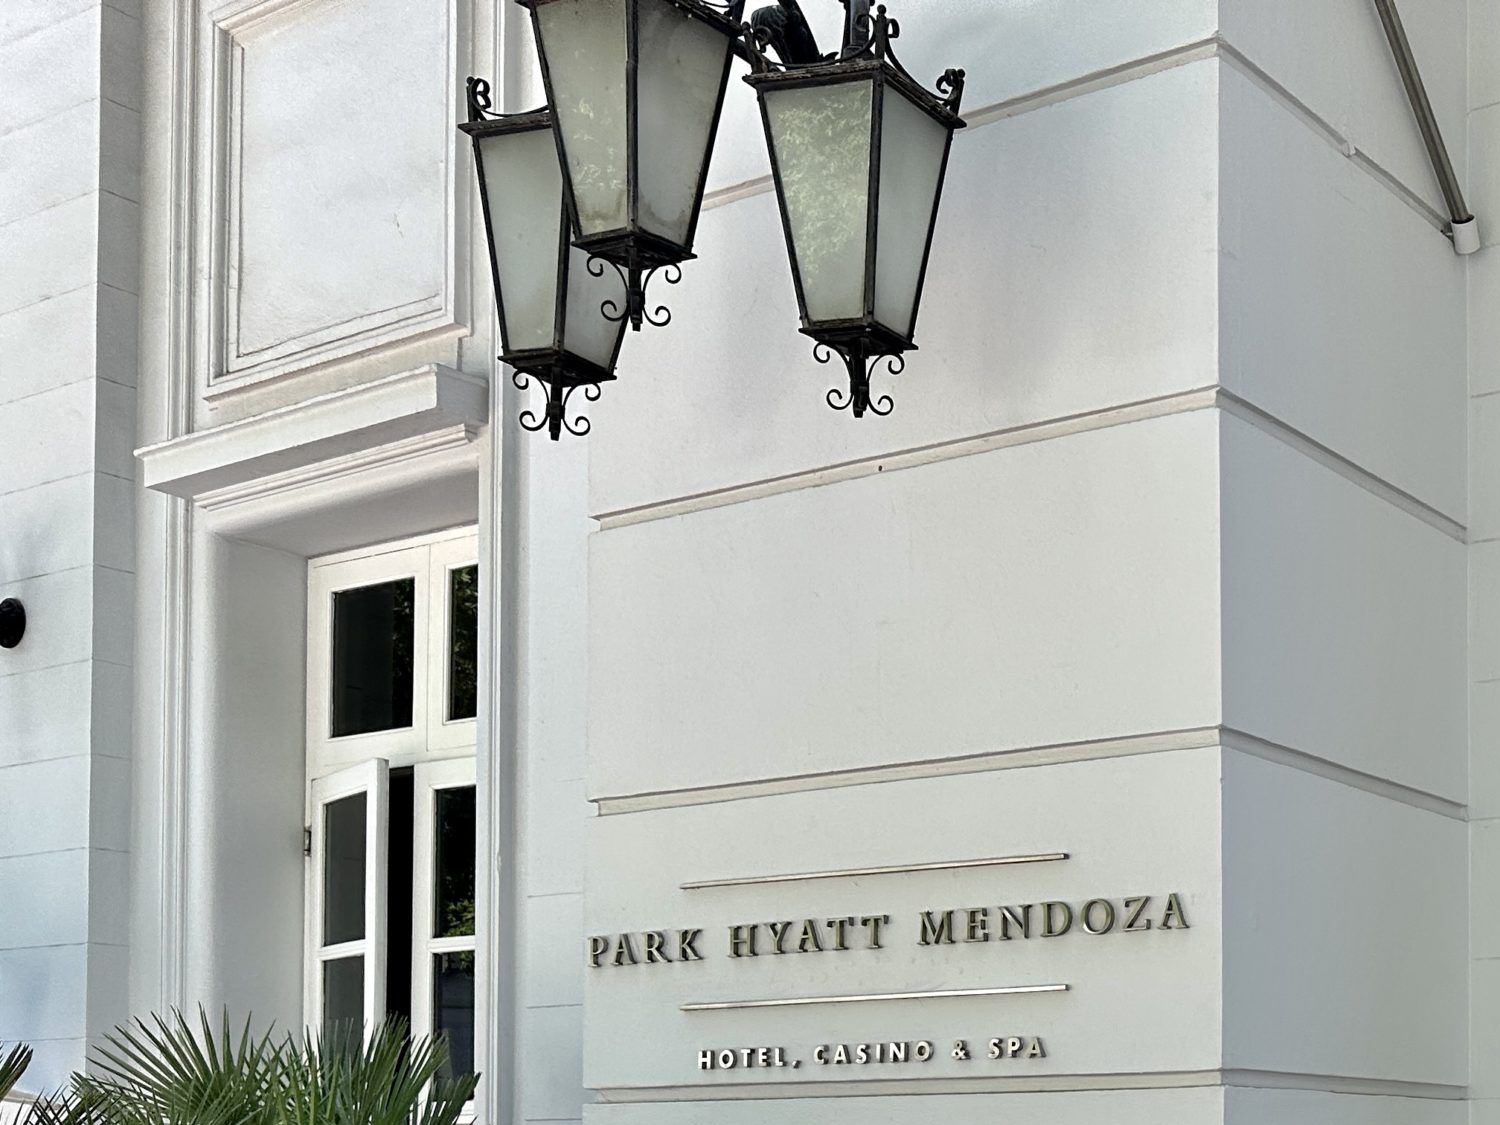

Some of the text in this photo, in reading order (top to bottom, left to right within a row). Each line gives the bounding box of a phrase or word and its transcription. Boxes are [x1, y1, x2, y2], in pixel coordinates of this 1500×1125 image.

[587, 892, 1191, 968] PARK HYATT MENDOZA
[697, 1036, 1047, 1070] HOTEL, CASINO & SPA
